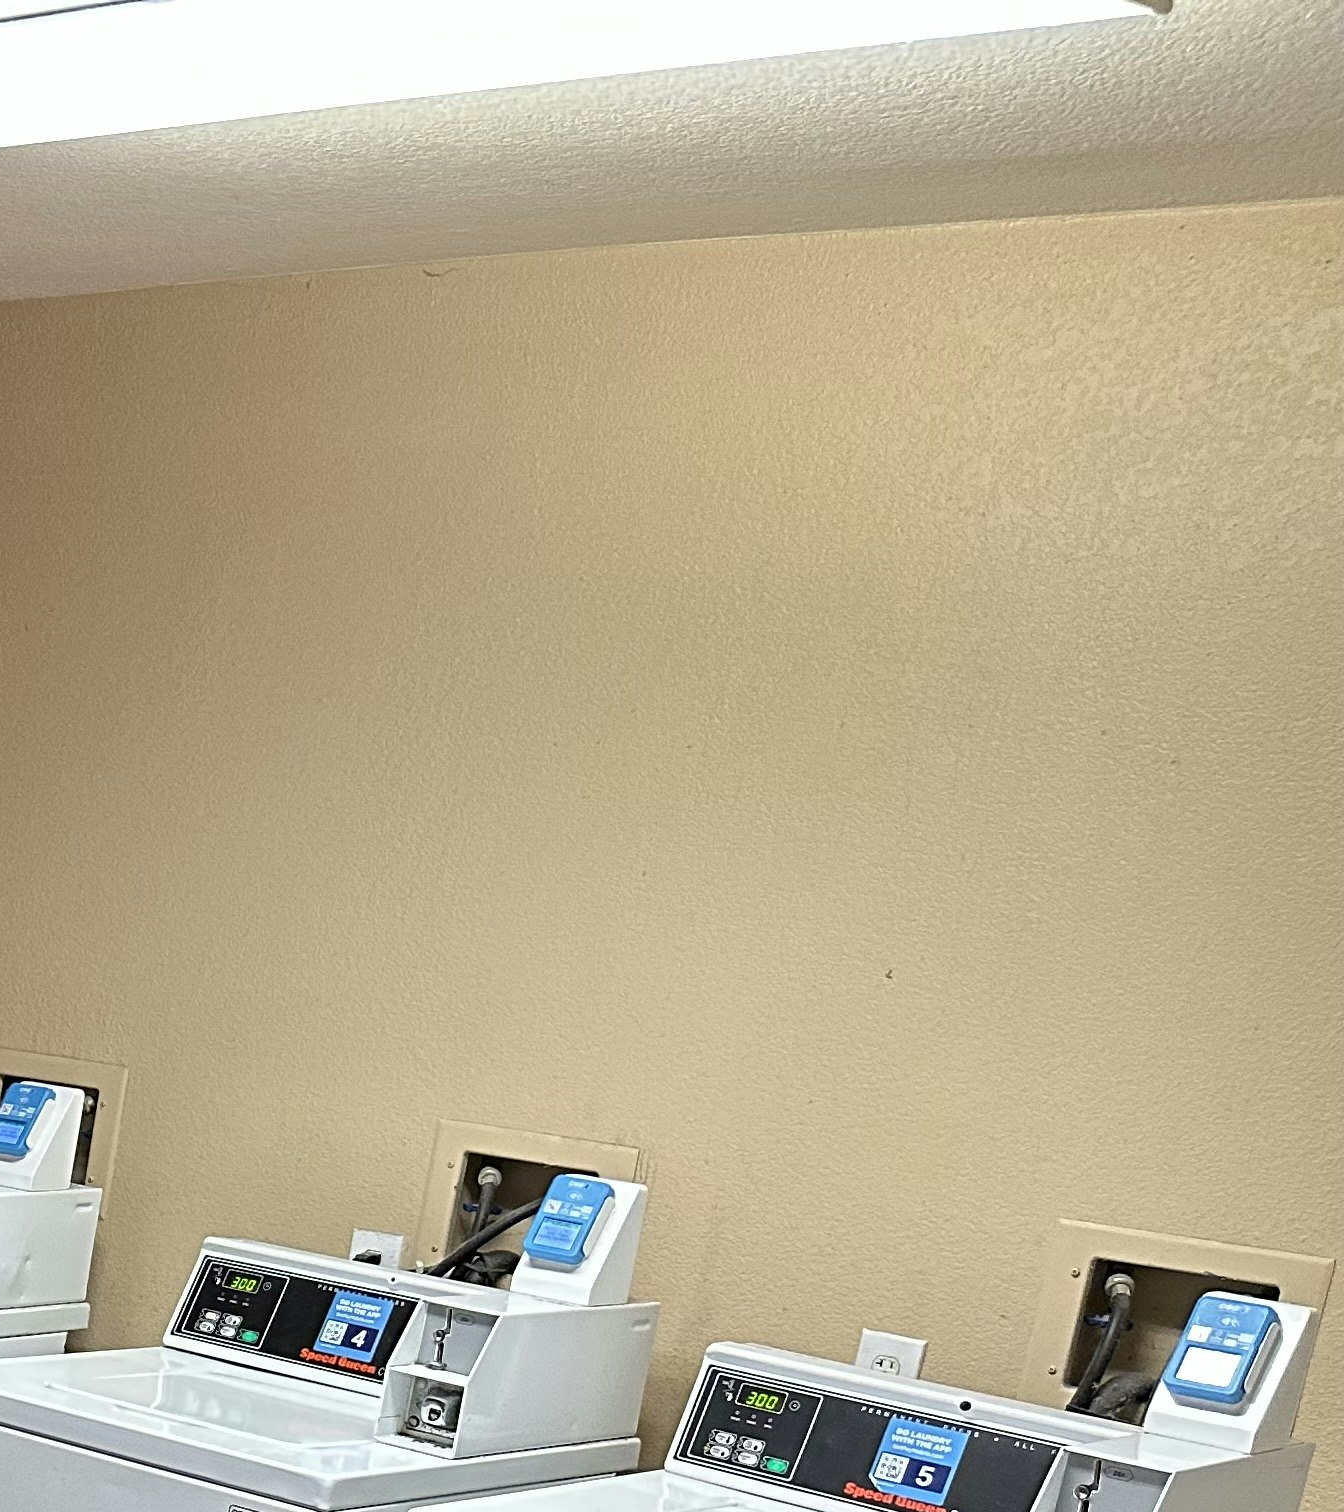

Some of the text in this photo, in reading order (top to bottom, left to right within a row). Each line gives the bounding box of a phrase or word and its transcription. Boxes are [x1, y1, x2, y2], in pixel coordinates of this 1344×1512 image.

[230, 1276, 257, 1292] 300
[350, 1329, 368, 1348] 4
[299, 1347, 337, 1365] Speed
[338, 1355, 377, 1375] Queen
[745, 1391, 779, 1410] 300
[891, 1433, 953, 1454] WITH THE APP
[910, 1429, 953, 1446] LAUNDRY
[1014, 1440, 1036, 1451] ALL
[914, 1465, 936, 1487] 5
[843, 1481, 898, 1505] Speed
